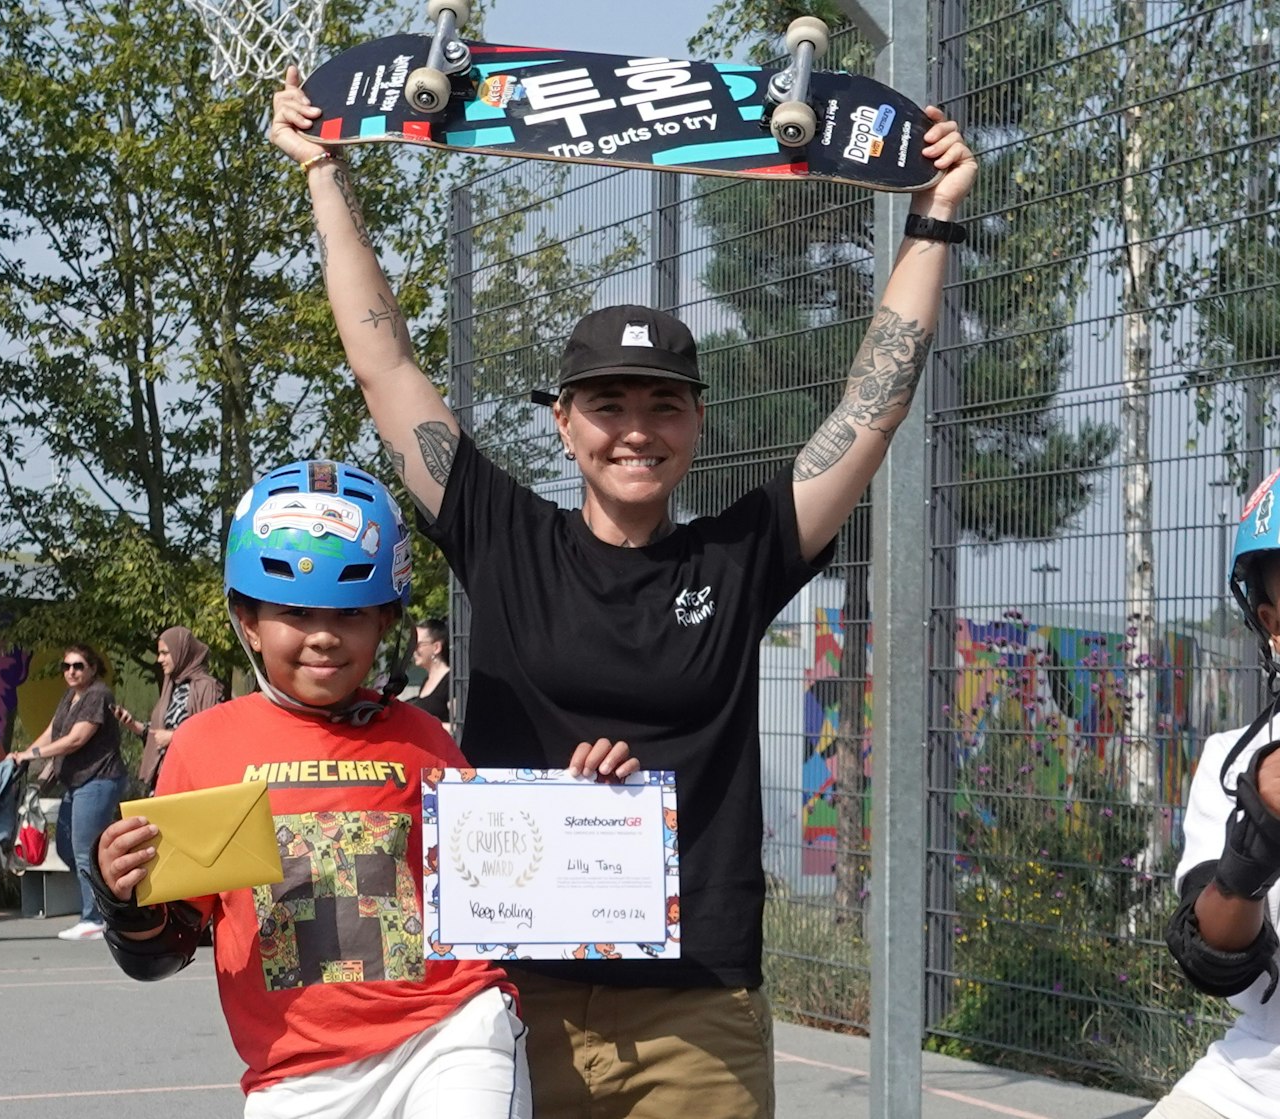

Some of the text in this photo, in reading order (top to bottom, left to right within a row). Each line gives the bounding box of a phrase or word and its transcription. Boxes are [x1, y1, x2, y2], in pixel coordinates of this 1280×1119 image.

[520, 57, 713, 138] 투혼
[821, 121, 836, 146] Galaxy
[847, 107, 880, 160] Drop in
[875, 107, 894, 134] Samsung
[548, 113, 718, 158] The guts to try
[675, 586, 711, 607] KEEP
[242, 760, 407, 787] MINECRAFT
[487, 812, 506, 826] THE
[564, 816, 642, 828] SkateboardGB
[466, 830, 527, 857] CRUISERS
[481, 860, 514, 877] AWARD
[567, 859, 623, 874] Lilly Tang
[498, 901, 533, 929] Rolling
